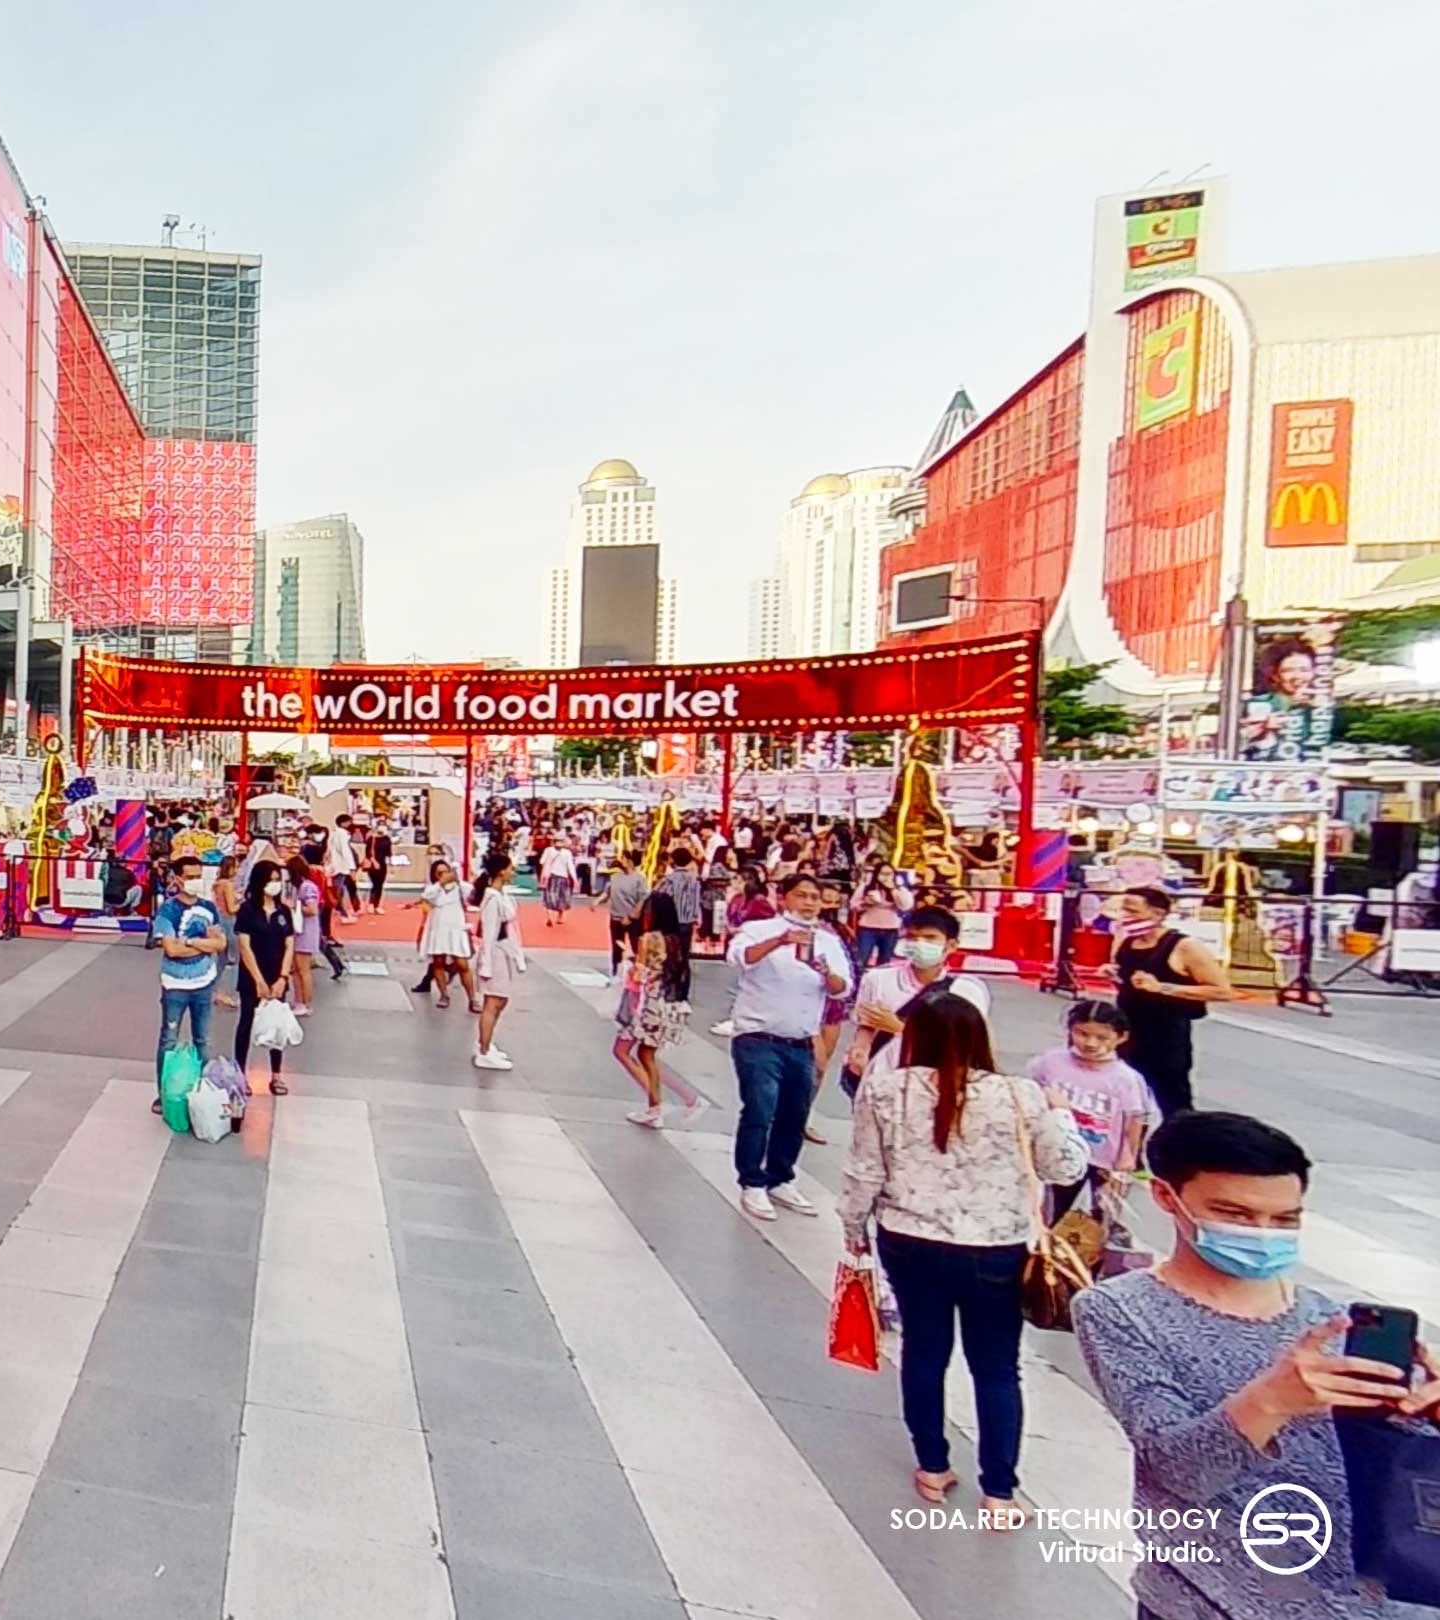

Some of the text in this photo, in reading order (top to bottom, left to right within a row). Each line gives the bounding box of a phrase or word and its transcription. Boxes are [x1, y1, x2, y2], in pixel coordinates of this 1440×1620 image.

[242, 680, 739, 721] the wOrld food market
